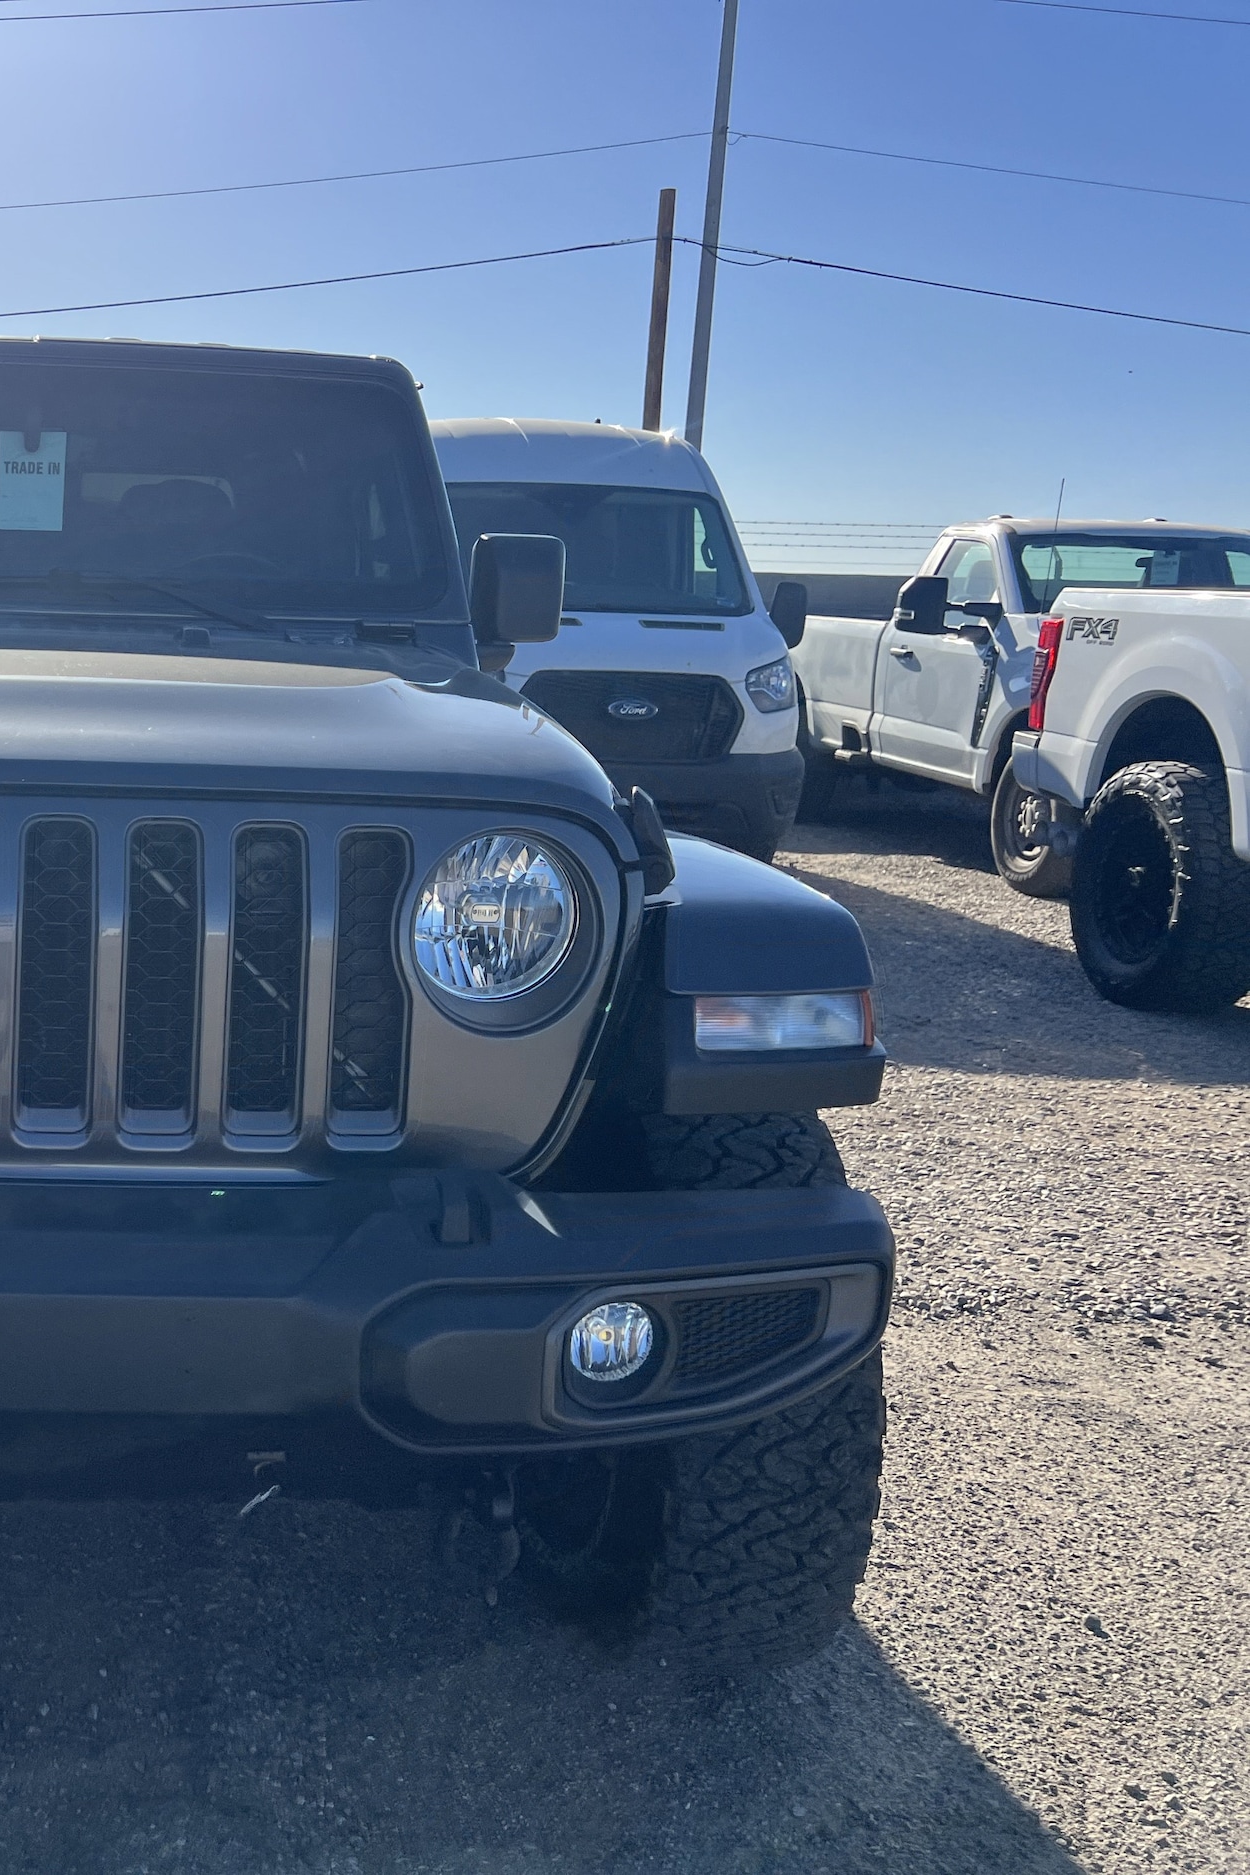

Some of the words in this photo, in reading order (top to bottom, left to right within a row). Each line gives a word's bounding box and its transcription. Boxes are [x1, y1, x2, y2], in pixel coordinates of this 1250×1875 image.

[3, 461, 44, 475] TRADE
[48, 462, 61, 475] IN
[1065, 616, 1120, 641] FX4
